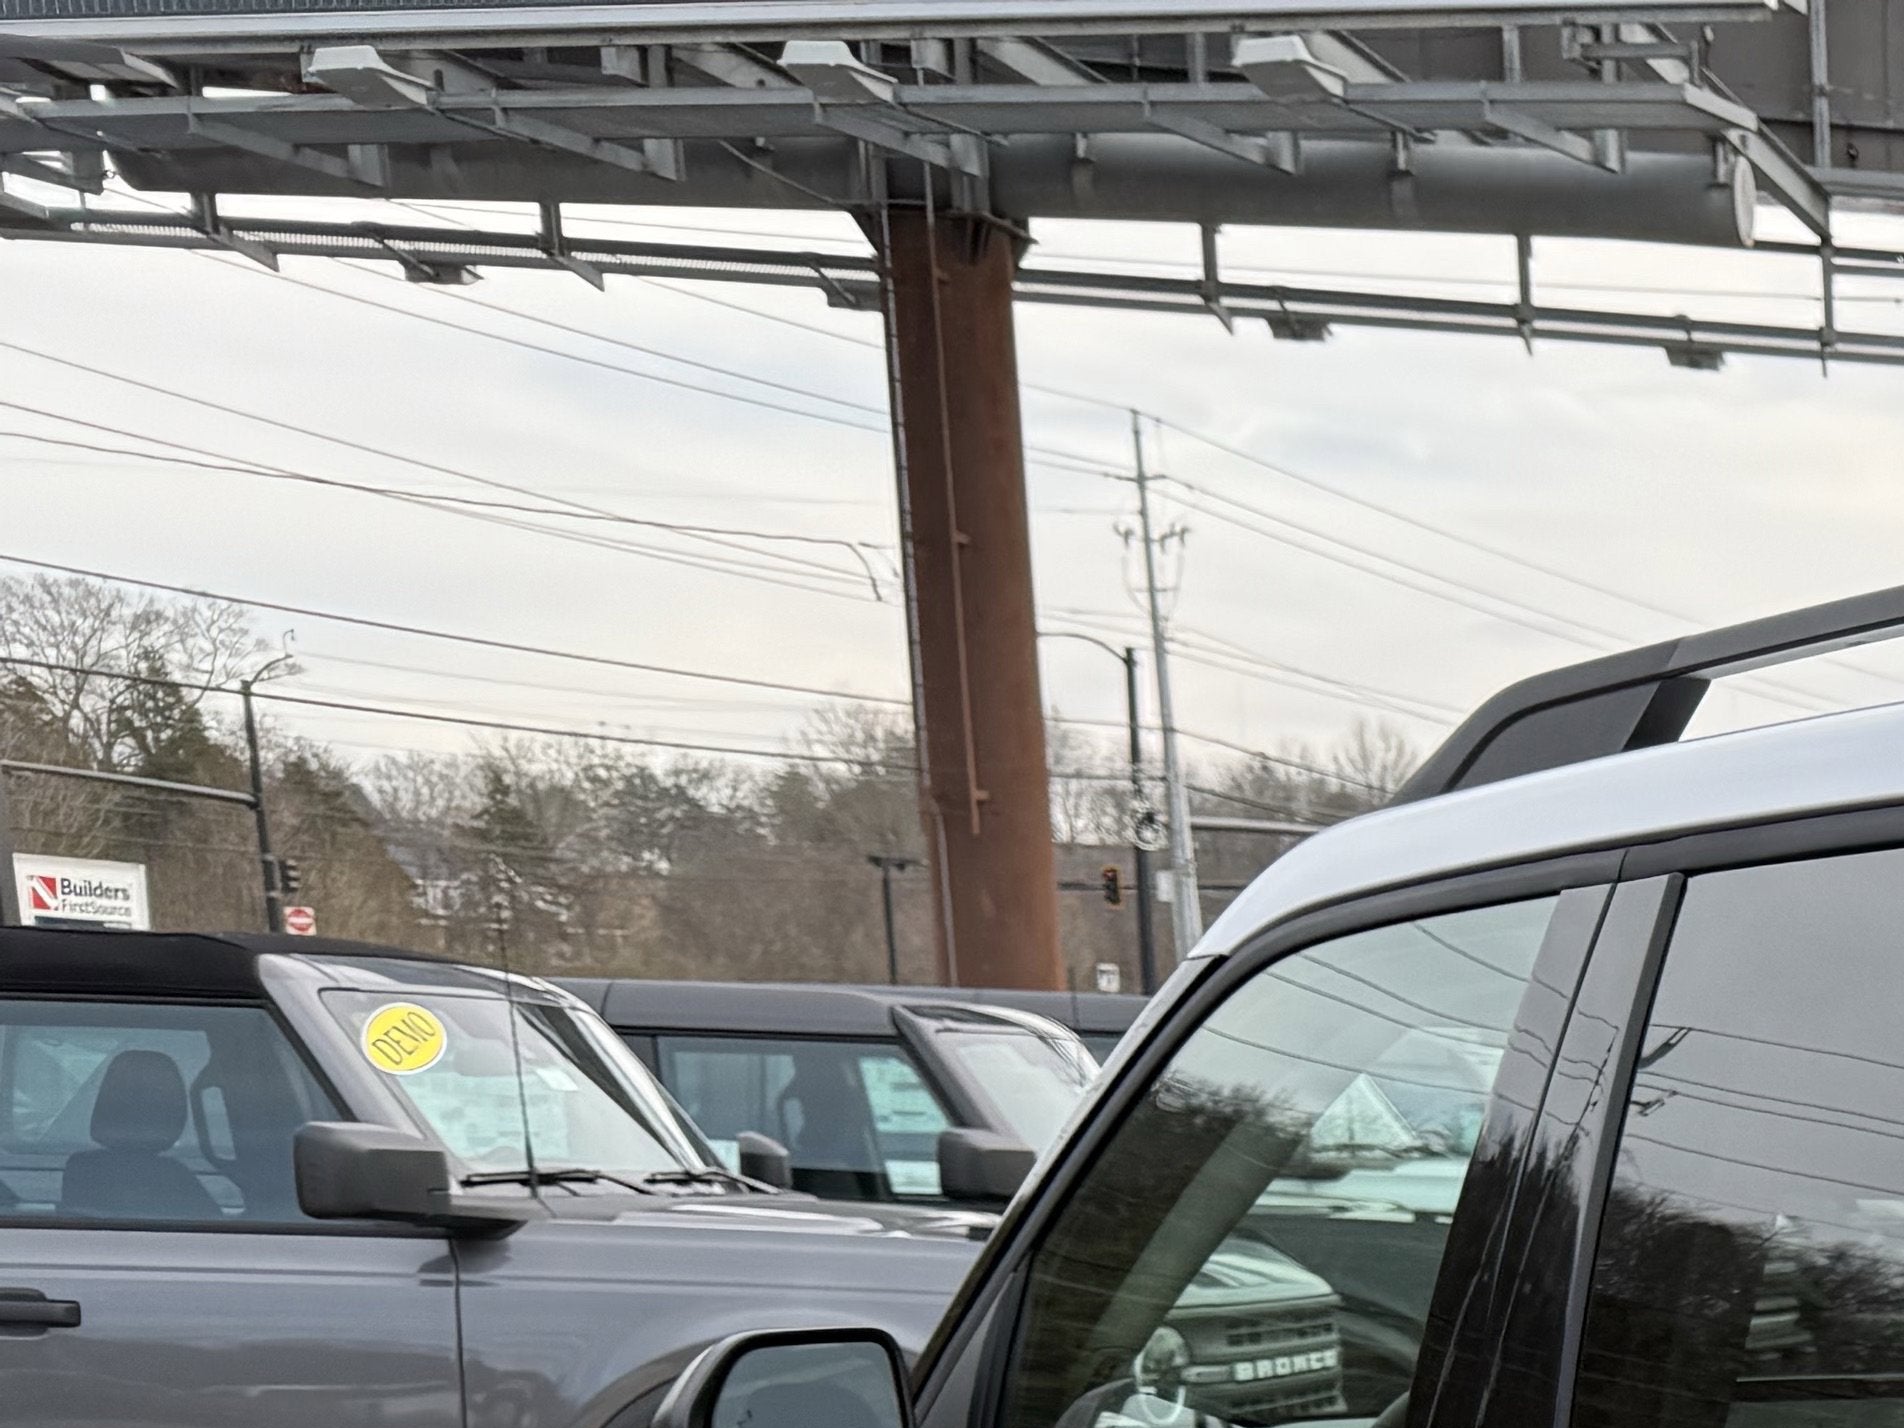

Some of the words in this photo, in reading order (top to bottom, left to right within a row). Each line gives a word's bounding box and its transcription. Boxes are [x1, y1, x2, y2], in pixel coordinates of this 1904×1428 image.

[60, 877, 130, 901] Builders
[61, 898, 132, 917] FirstSource
[371, 1011, 437, 1066] DEMO
[1234, 1347, 1338, 1381] BRONCO
